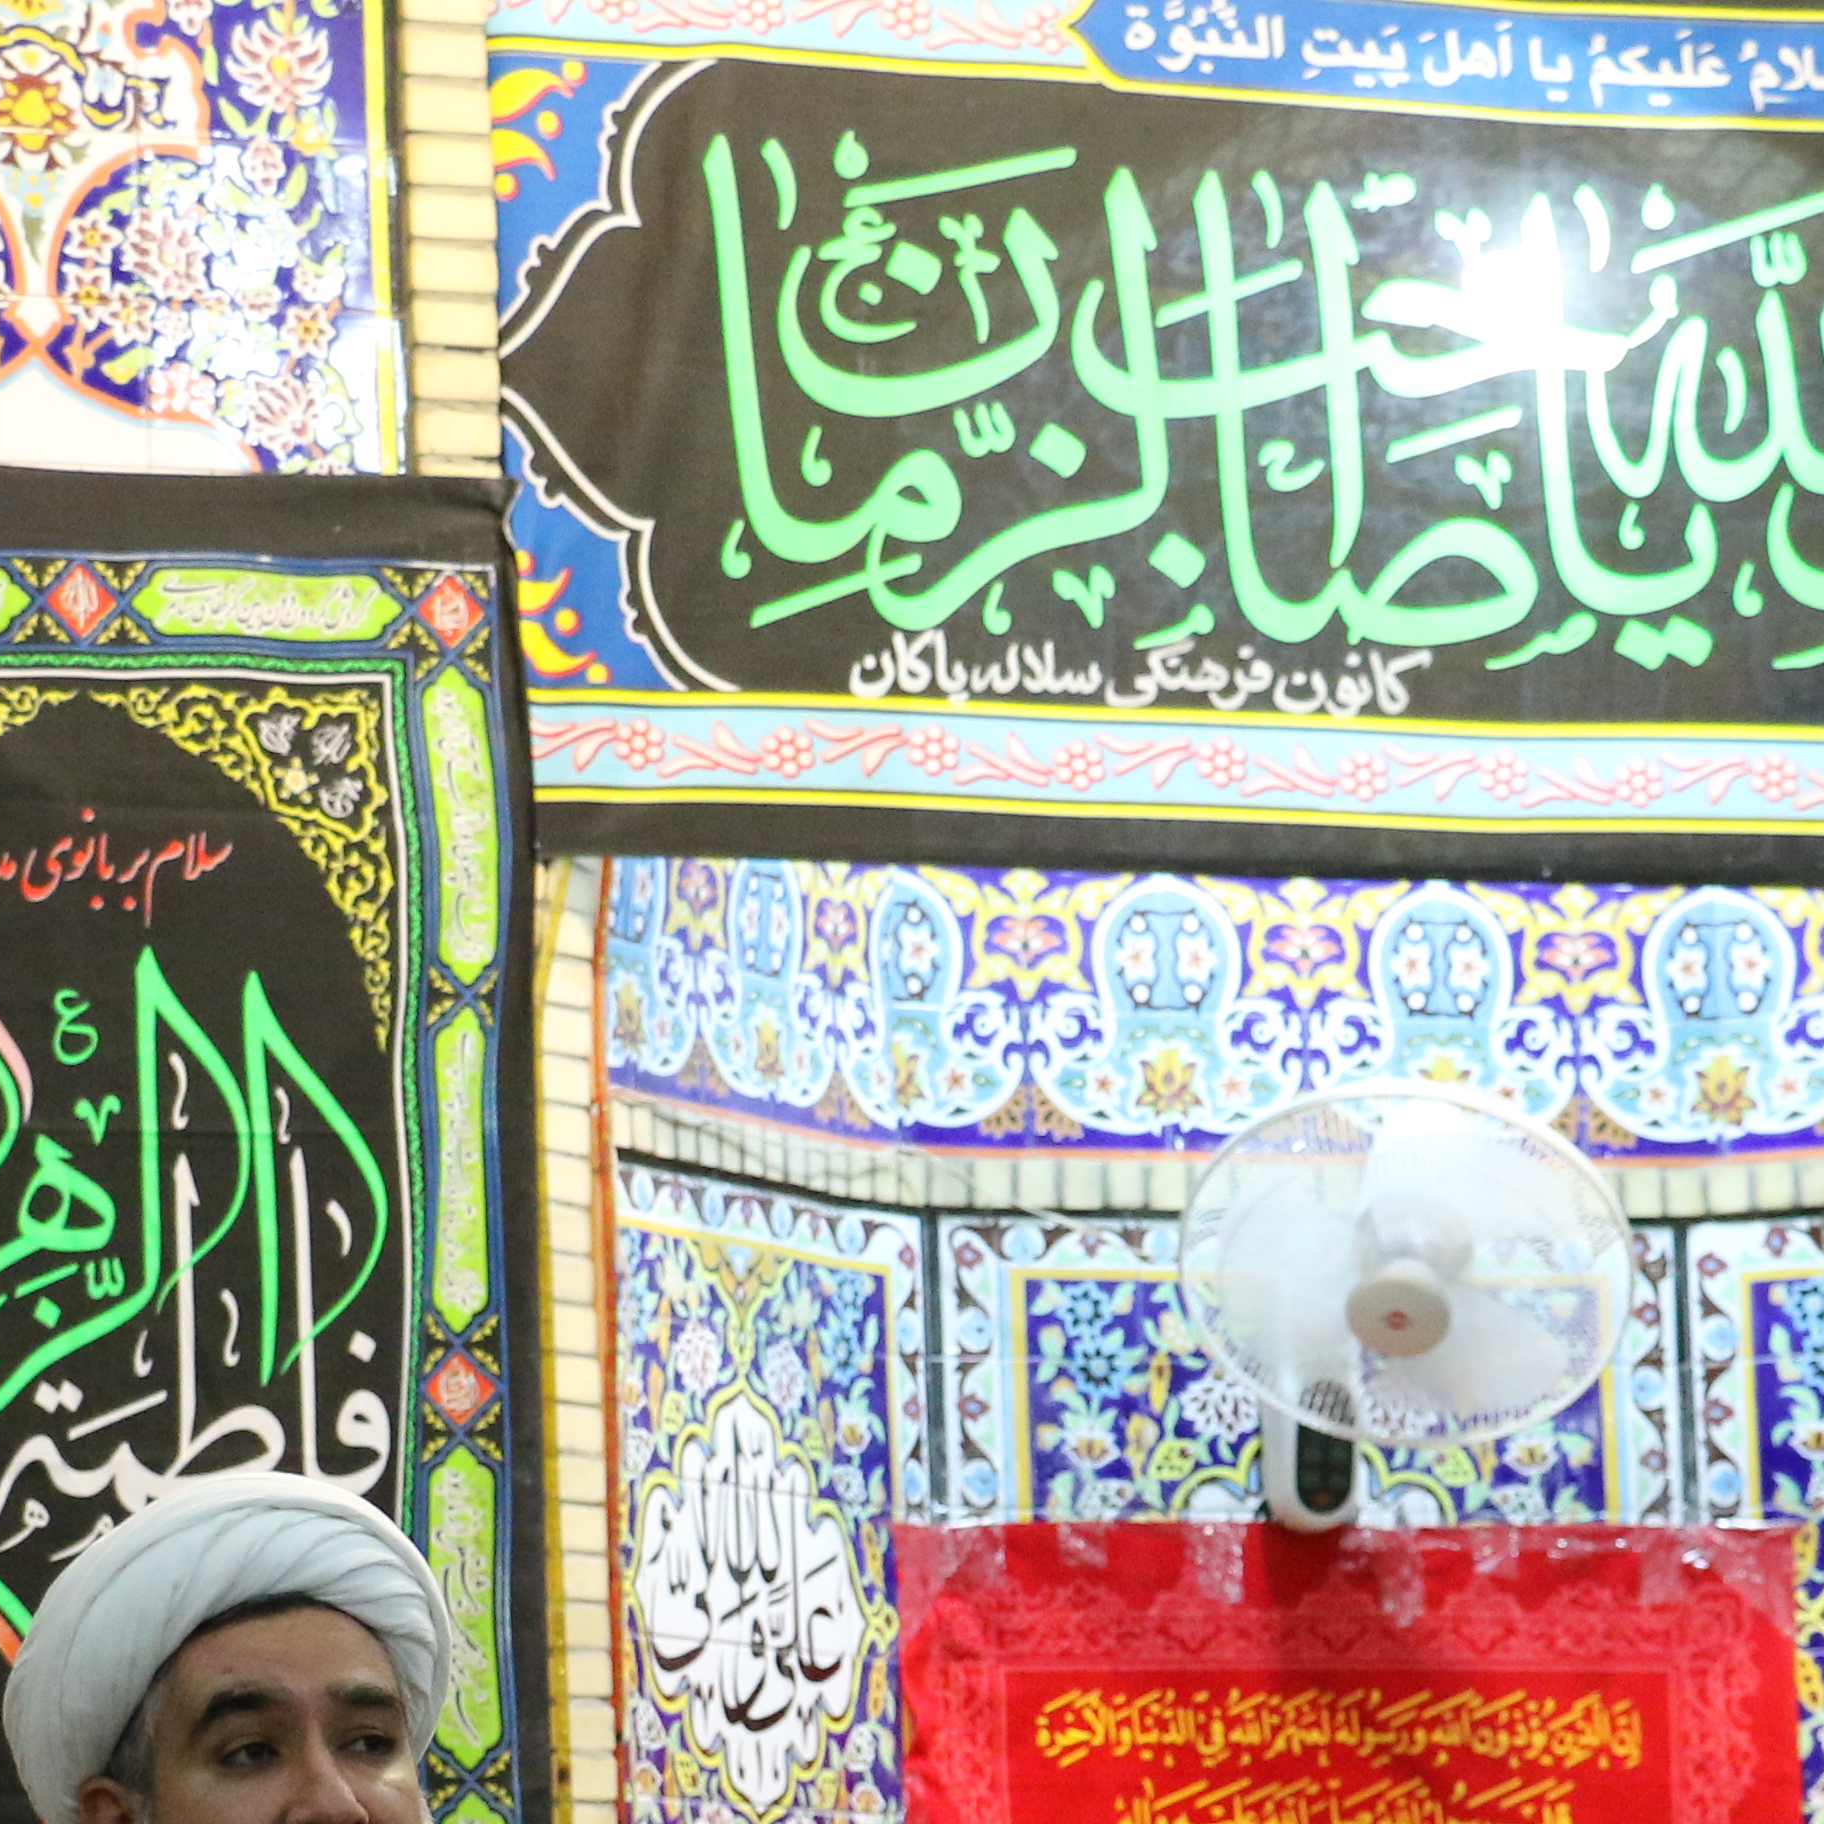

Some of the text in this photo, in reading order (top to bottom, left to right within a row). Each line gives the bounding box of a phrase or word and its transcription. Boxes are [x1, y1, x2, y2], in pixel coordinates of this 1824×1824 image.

[1528, 36, 1574, 102] یا
[1102, 638, 1275, 712] فرهنگی
[1275, 647, 1434, 717] کانون
[19, 806, 115, 910] بانوی
[116, 849, 152, 912] بر
[143, 829, 234, 929] سلام
